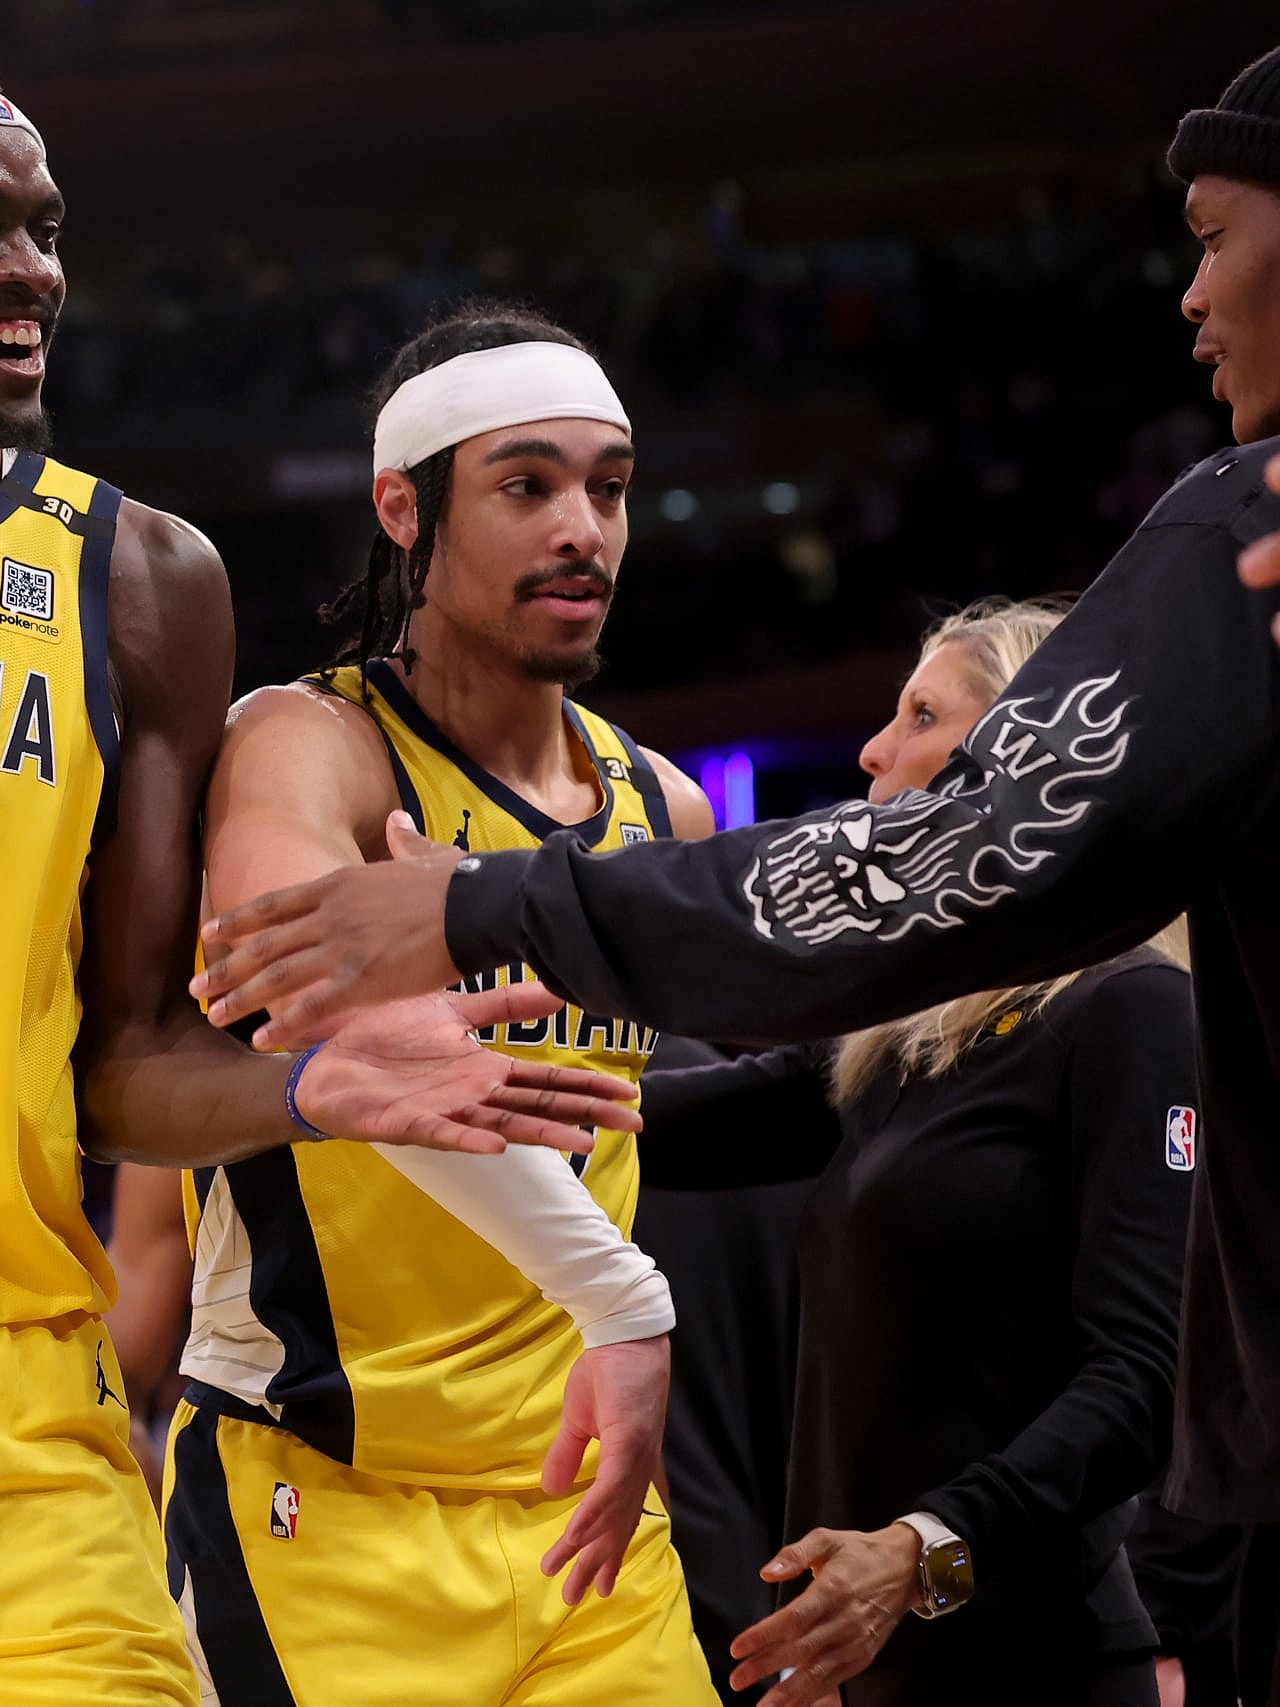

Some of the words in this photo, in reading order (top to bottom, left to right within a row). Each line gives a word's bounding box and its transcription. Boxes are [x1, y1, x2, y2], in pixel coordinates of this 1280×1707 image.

[42, 497, 73, 525] 30
[989, 721, 1058, 781] W
[446, 961, 660, 1055] NDIAN
[273, 1525, 287, 1537] NBA
